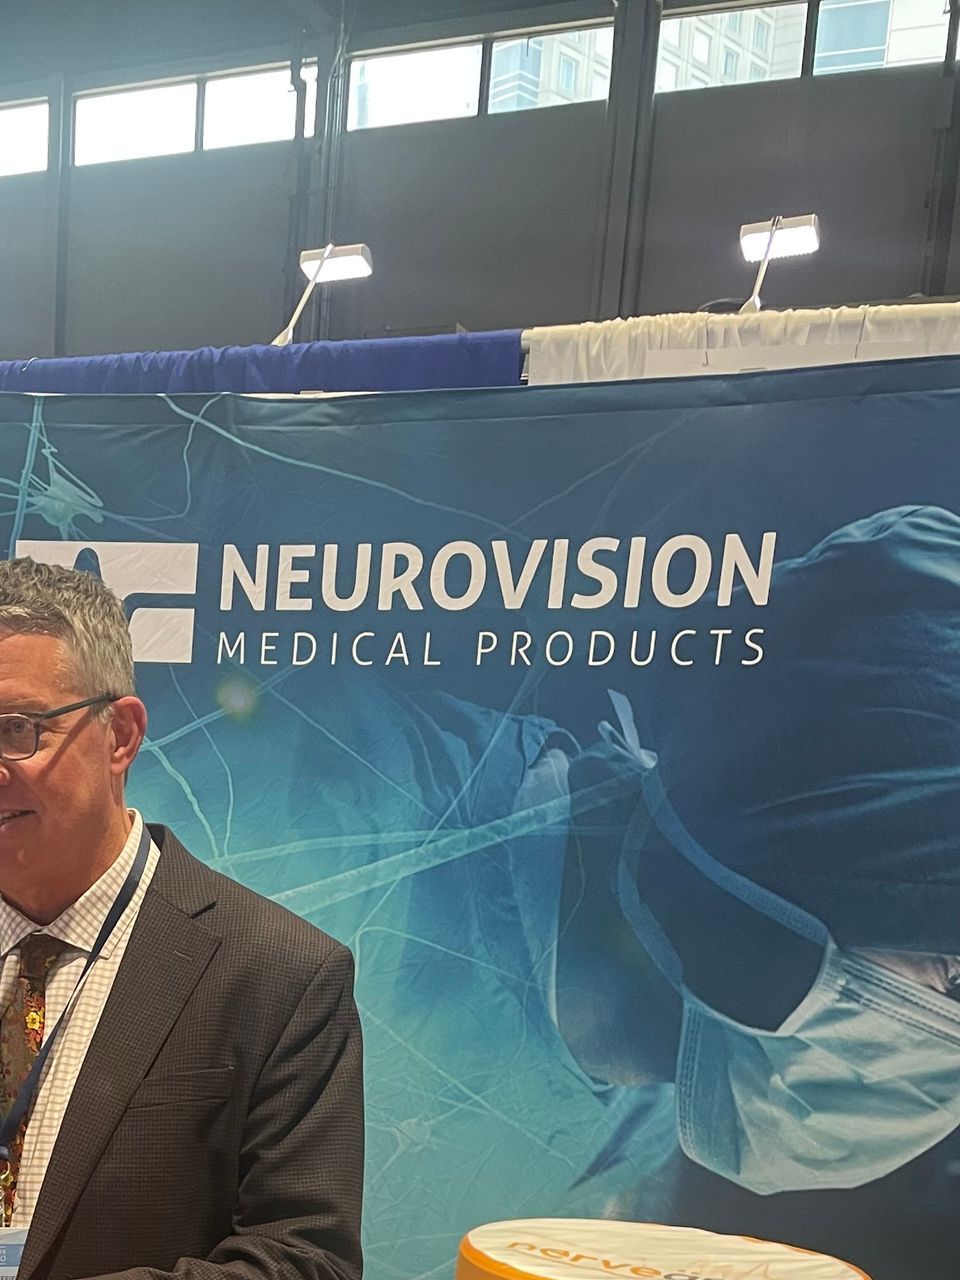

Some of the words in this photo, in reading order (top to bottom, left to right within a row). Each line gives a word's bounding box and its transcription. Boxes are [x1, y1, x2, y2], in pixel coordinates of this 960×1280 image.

[221, 532, 777, 612] NEUROVISION
[217, 631, 441, 666] MEDICAL
[476, 628, 766, 666] PRODUCTS
